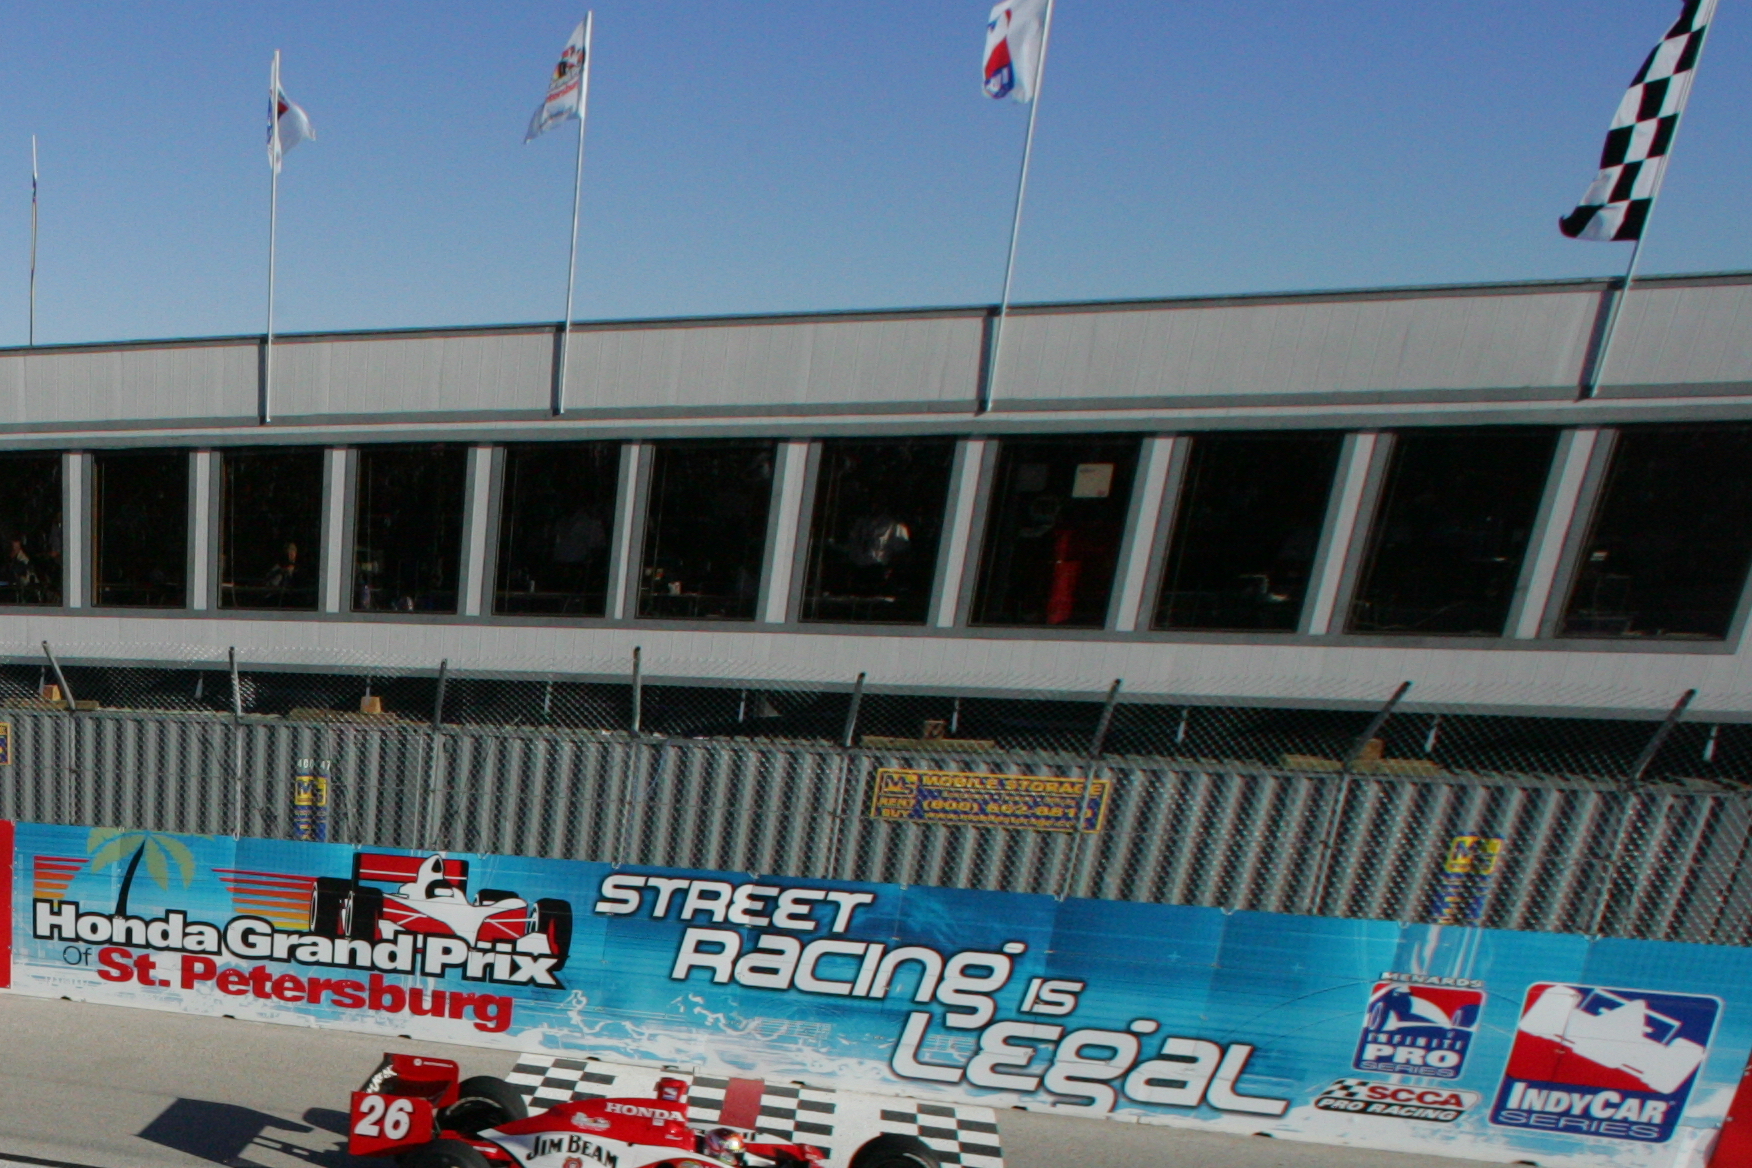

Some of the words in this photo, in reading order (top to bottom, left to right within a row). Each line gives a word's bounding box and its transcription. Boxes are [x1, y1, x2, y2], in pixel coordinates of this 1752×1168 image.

[922, 776, 998, 788] MOBILE
[596, 874, 875, 934] STREET
[34, 901, 219, 956] Honda
[223, 913, 419, 973] Grand
[422, 934, 563, 988] Prix
[62, 944, 94, 965] Of
[97, 947, 172, 987] St.
[179, 953, 514, 1034] Petersburg
[1380, 972, 1485, 988] MENARDS
[1367, 1032, 1466, 1051] INFINITI
[1361, 1044, 1461, 1068] PRO
[1359, 1060, 1457, 1078] SERIES
[1366, 1086, 1464, 1108] SCCA
[353, 1094, 415, 1140] 26
[604, 1102, 686, 1122] HONDA
[1318, 1099, 1366, 1112] PRO
[1367, 1103, 1458, 1122] RACING
[1498, 1110, 1662, 1139] SERIES
[526, 1136, 565, 1161] JIM
